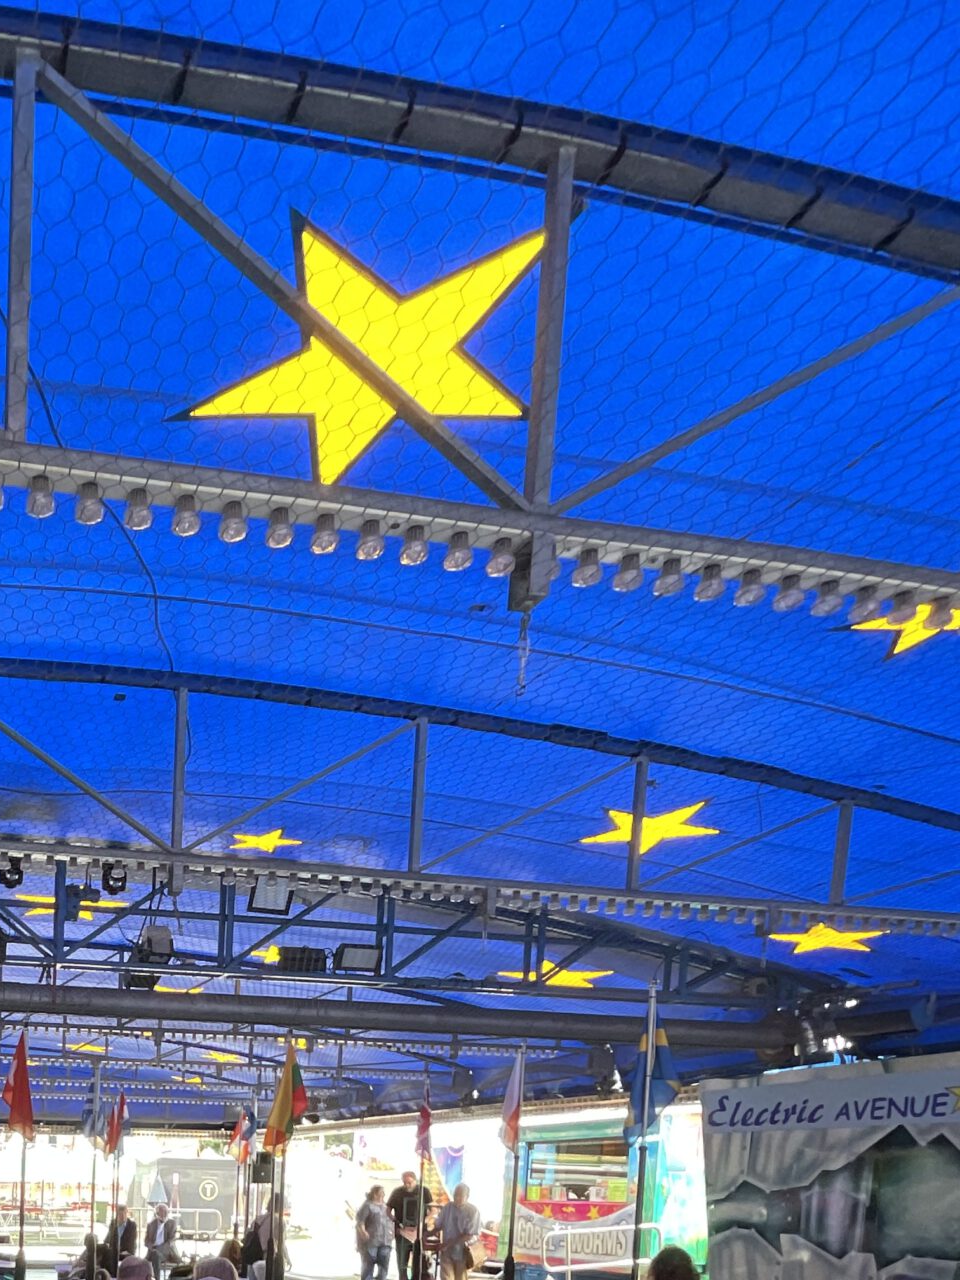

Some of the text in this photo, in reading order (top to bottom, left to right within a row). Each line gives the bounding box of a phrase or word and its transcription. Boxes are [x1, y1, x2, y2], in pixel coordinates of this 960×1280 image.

[708, 1093, 950, 1127] Electric AVENUE
[570, 1230, 627, 1256] WORMS
